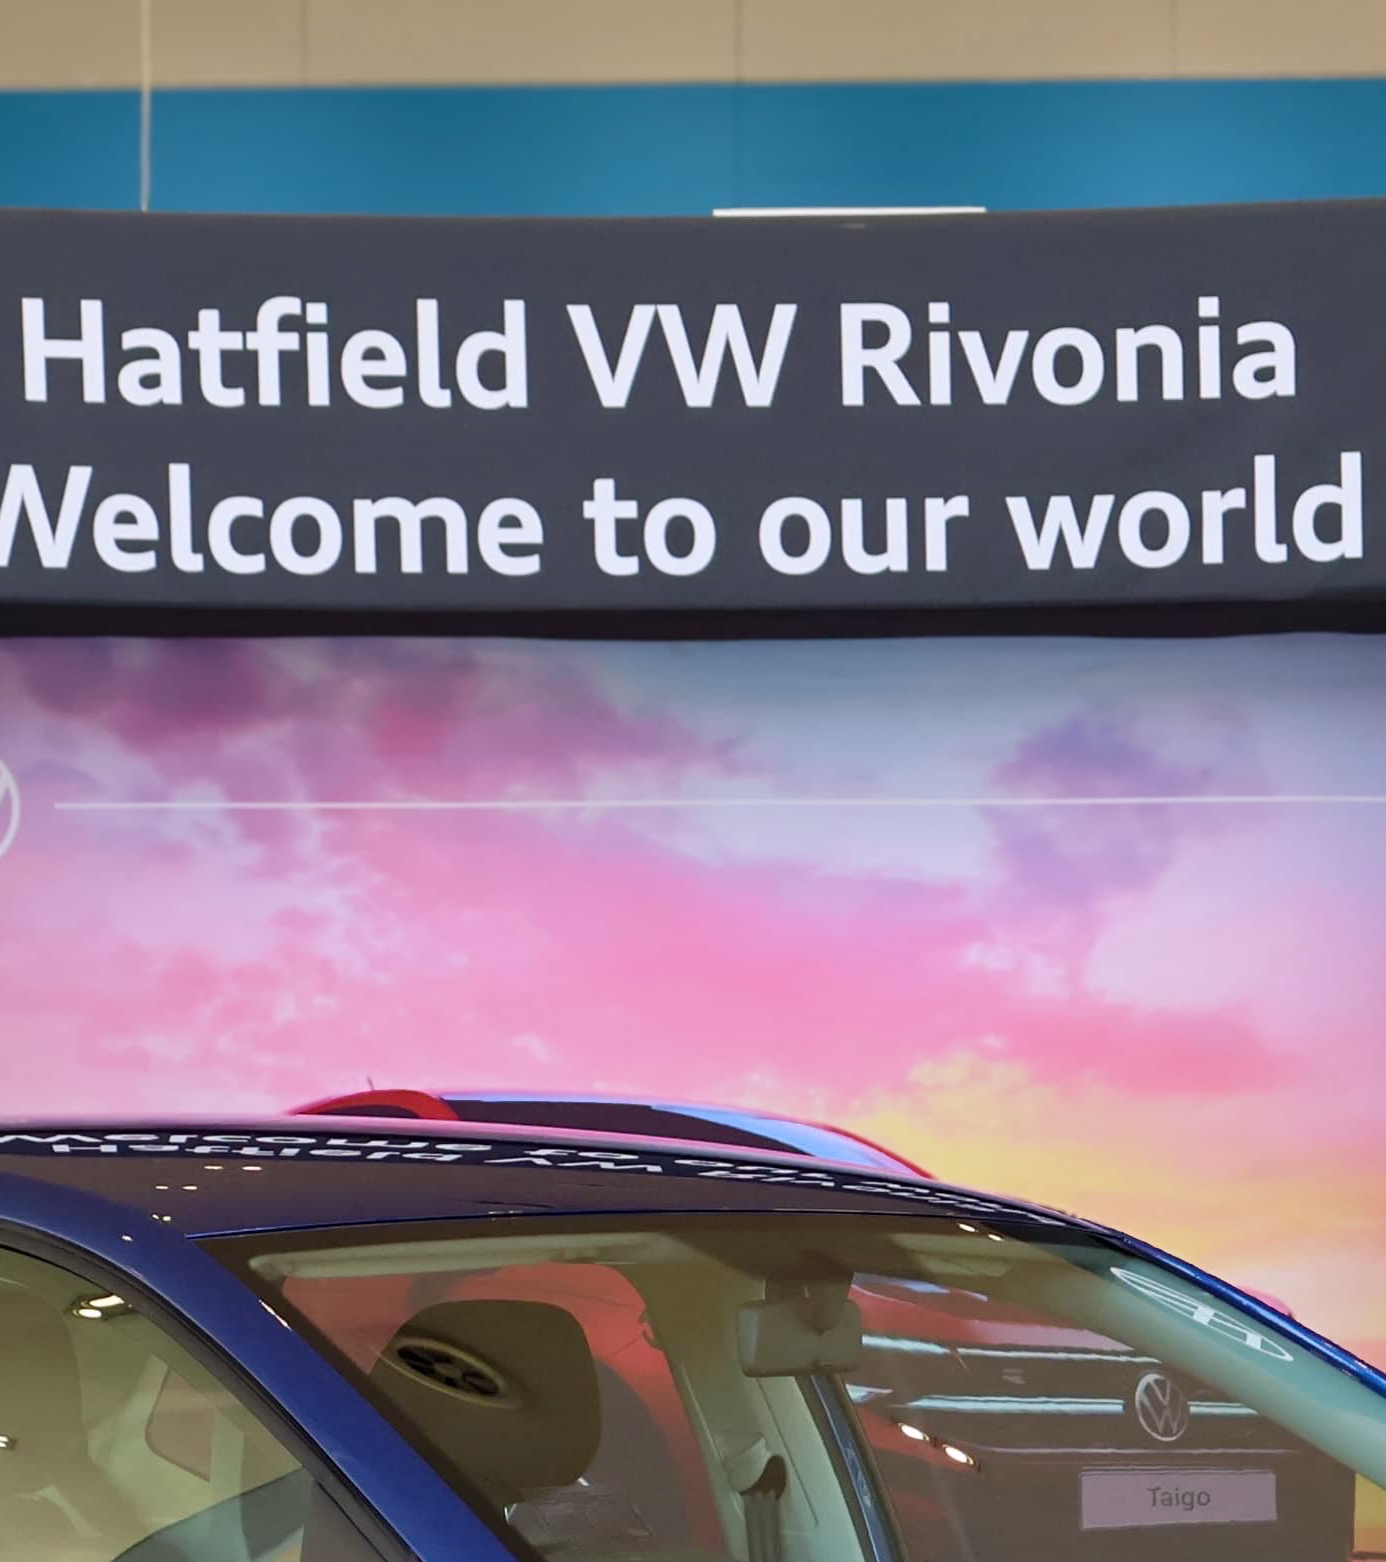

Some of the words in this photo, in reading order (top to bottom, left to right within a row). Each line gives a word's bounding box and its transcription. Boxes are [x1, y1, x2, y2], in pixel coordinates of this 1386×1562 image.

[21, 296, 528, 409] Hatfield
[566, 303, 798, 408] VW
[840, 296, 1296, 406] Rivonia
[582, 478, 716, 576] to
[759, 495, 970, 575] our
[1005, 451, 1363, 570] world
[1147, 1486, 1211, 1511] Taigo
